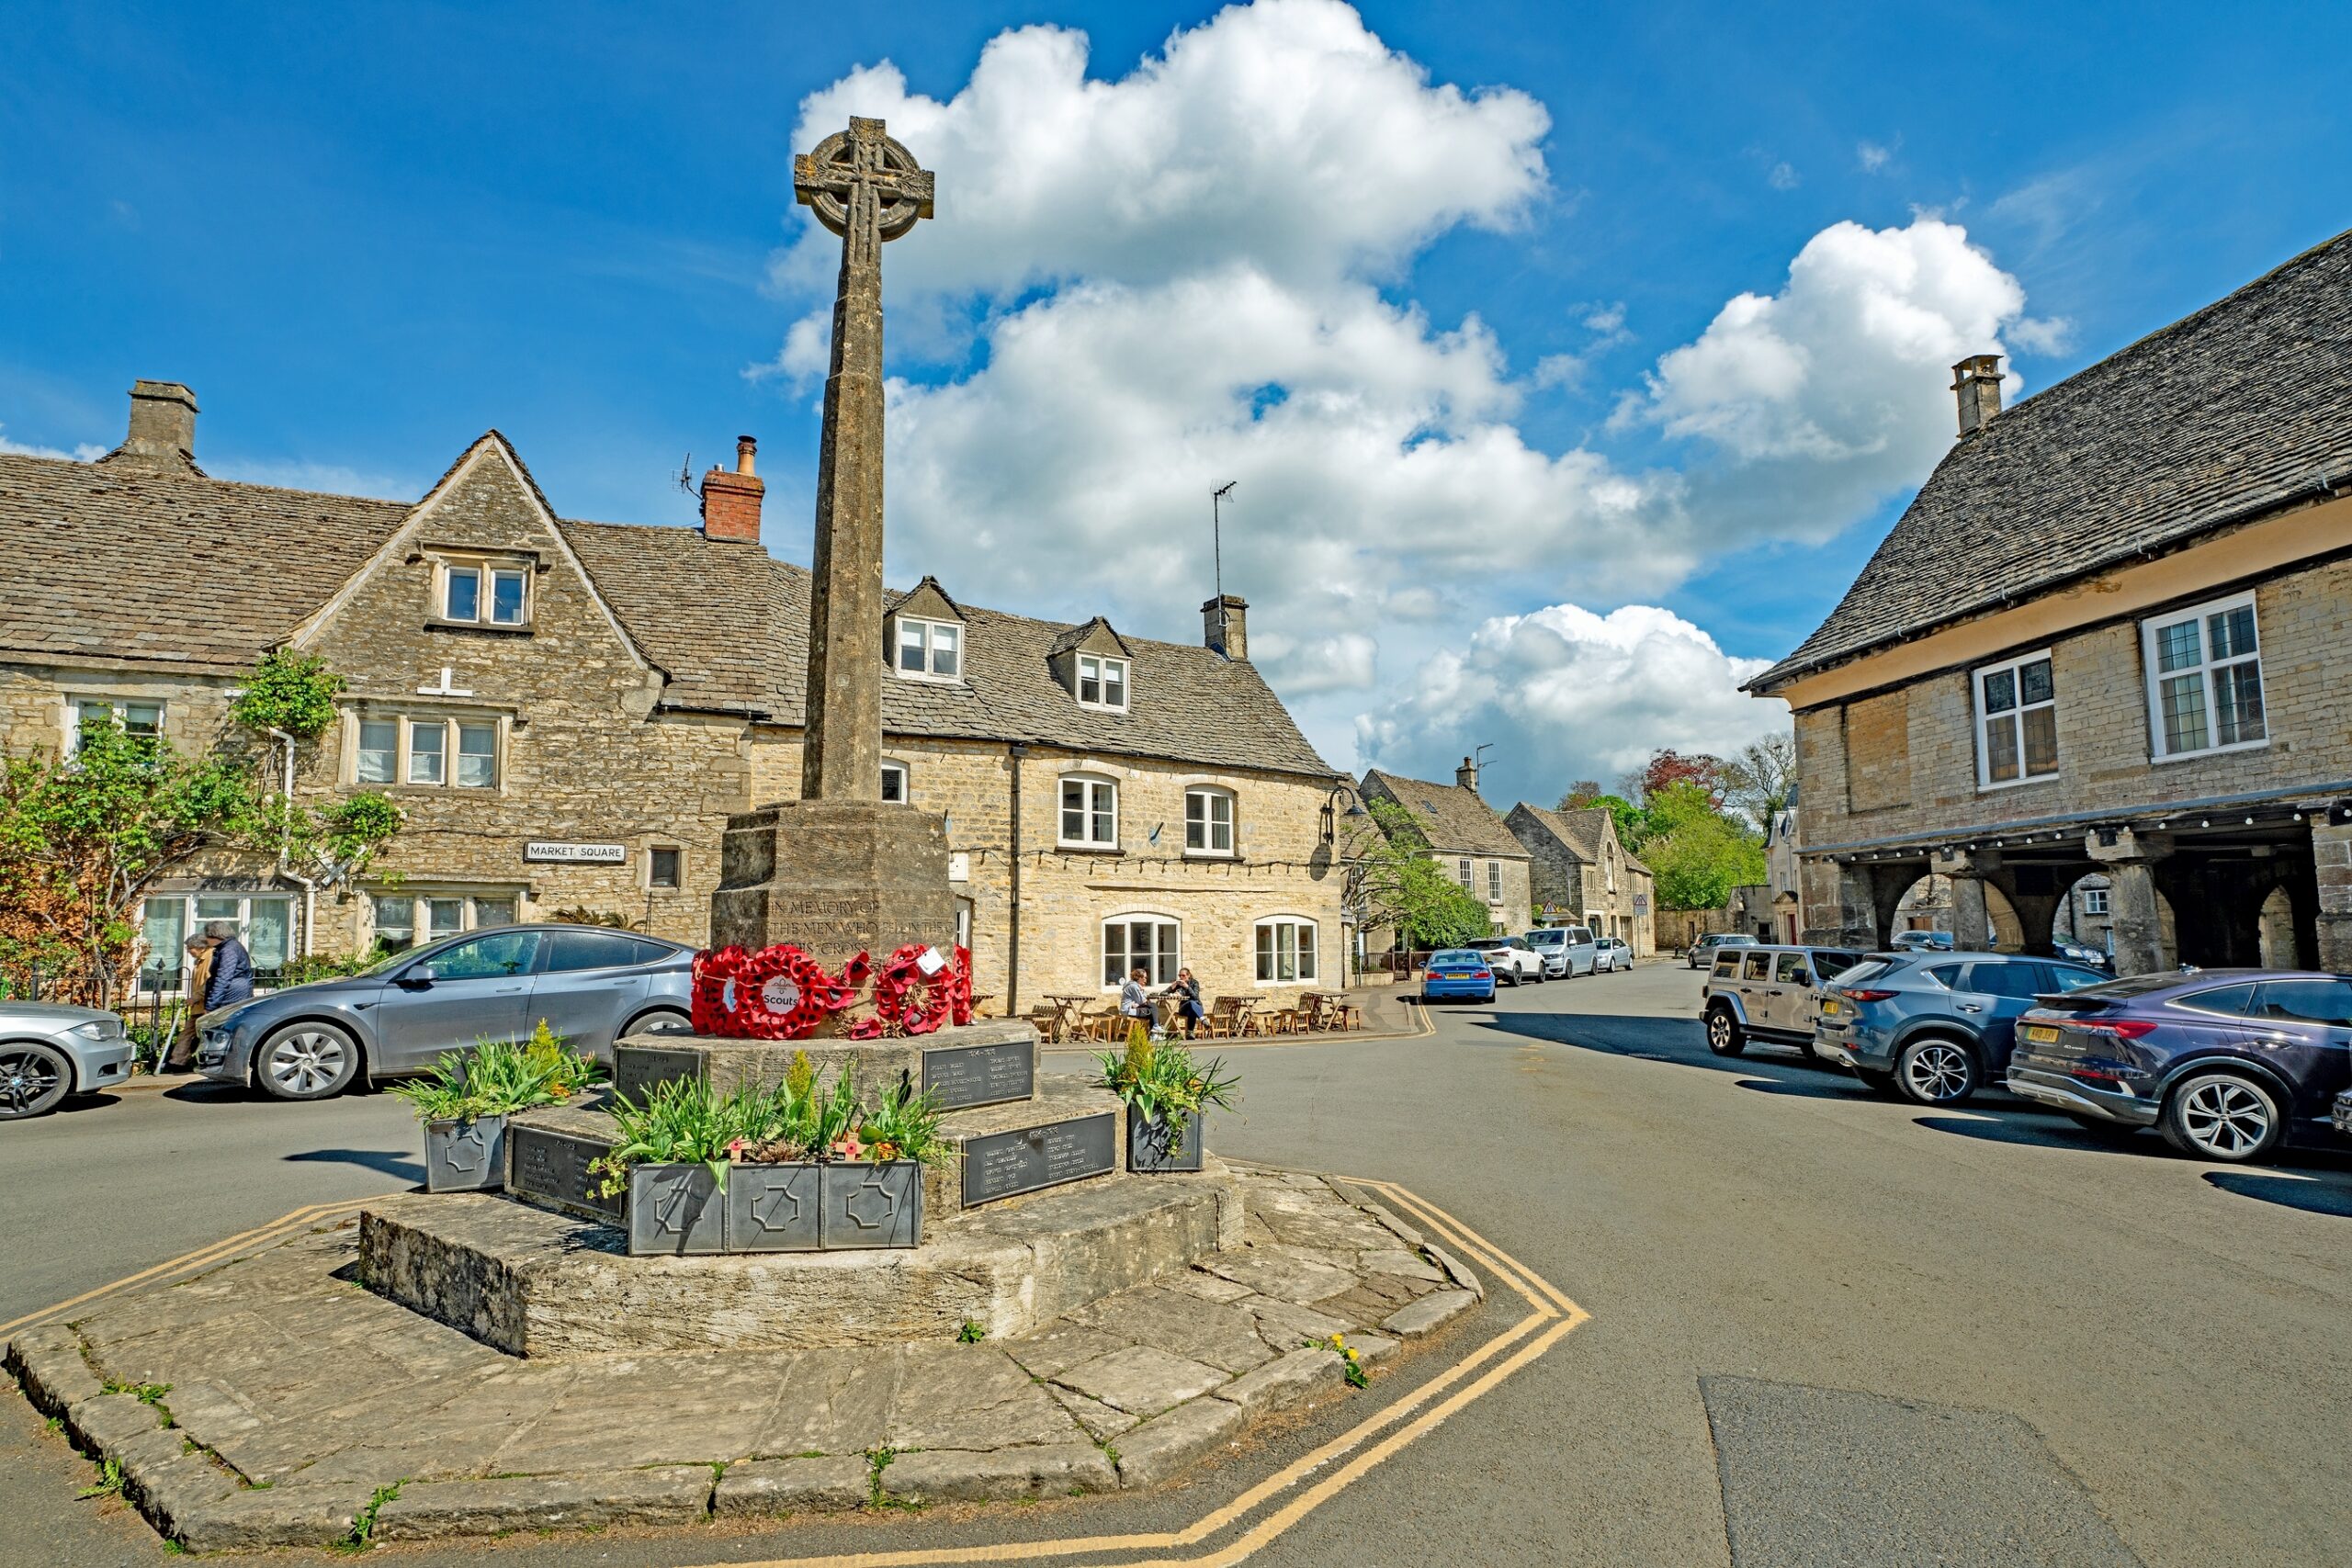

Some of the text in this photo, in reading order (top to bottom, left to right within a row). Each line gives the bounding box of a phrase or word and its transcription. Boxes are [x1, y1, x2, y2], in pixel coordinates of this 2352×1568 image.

[530, 846, 621, 857] MARKET SQUARE
[770, 900, 879, 915] IN MEMORY OF
[771, 921, 800, 935] THE
[802, 921, 836, 935] MEN
[840, 921, 878, 935] WHO
[820, 942, 870, 956] CROSS
[763, 994, 798, 1006] Scouts
